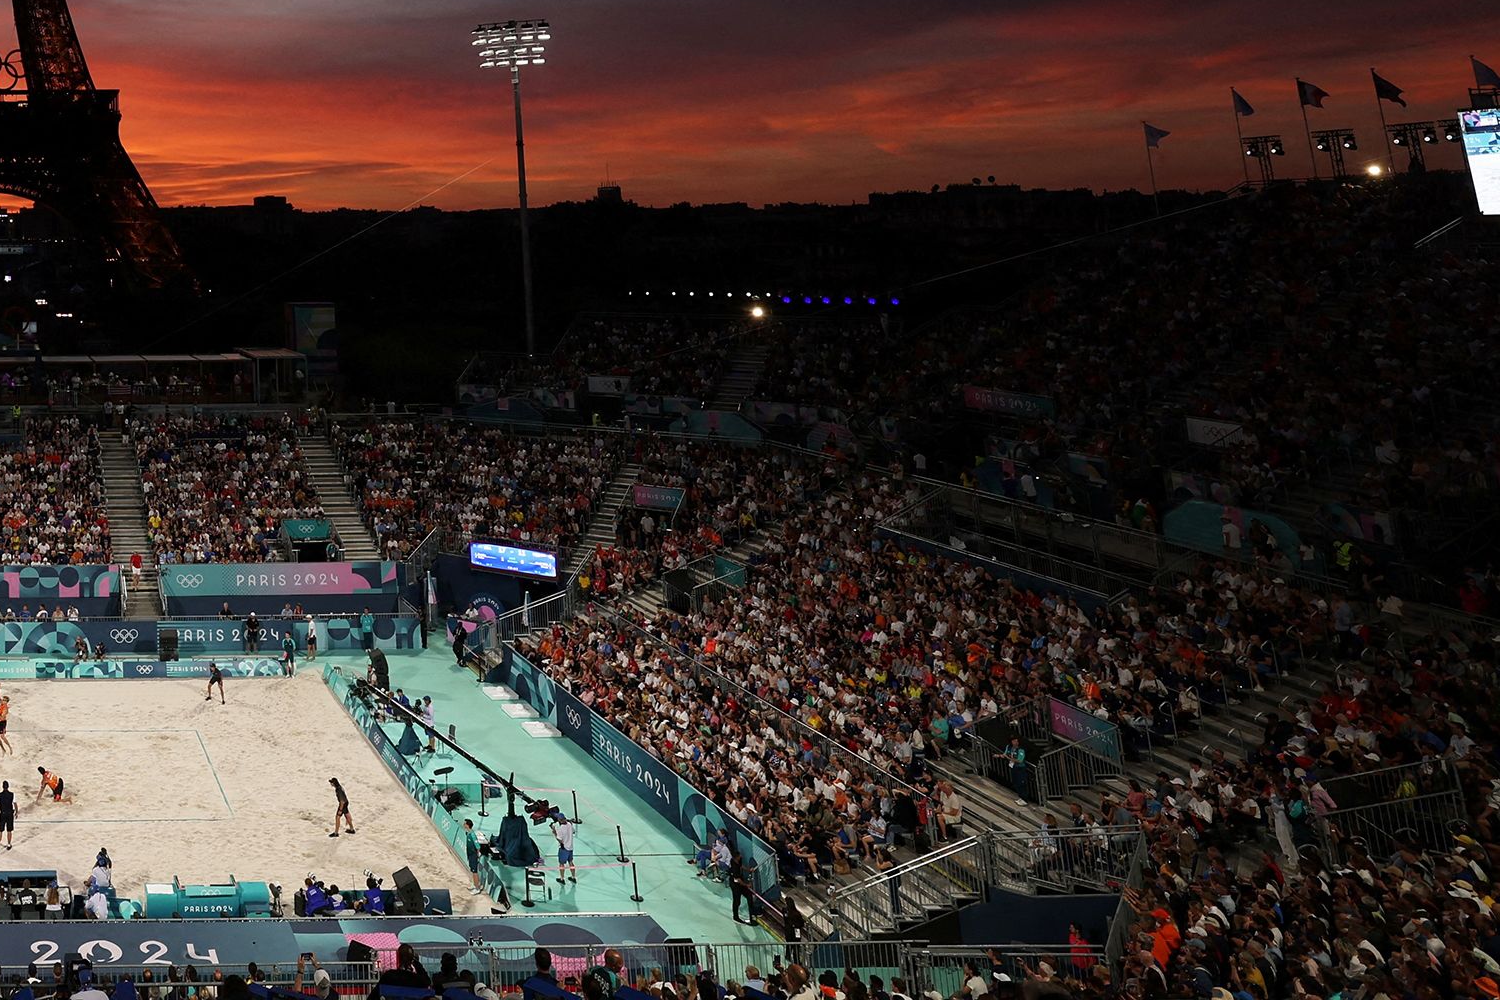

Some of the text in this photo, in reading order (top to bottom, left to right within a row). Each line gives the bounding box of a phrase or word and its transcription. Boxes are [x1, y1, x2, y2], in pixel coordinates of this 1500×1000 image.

[293, 573, 339, 585] 2024
[636, 763, 670, 804] 2024
[30, 940, 219, 966] 2024
